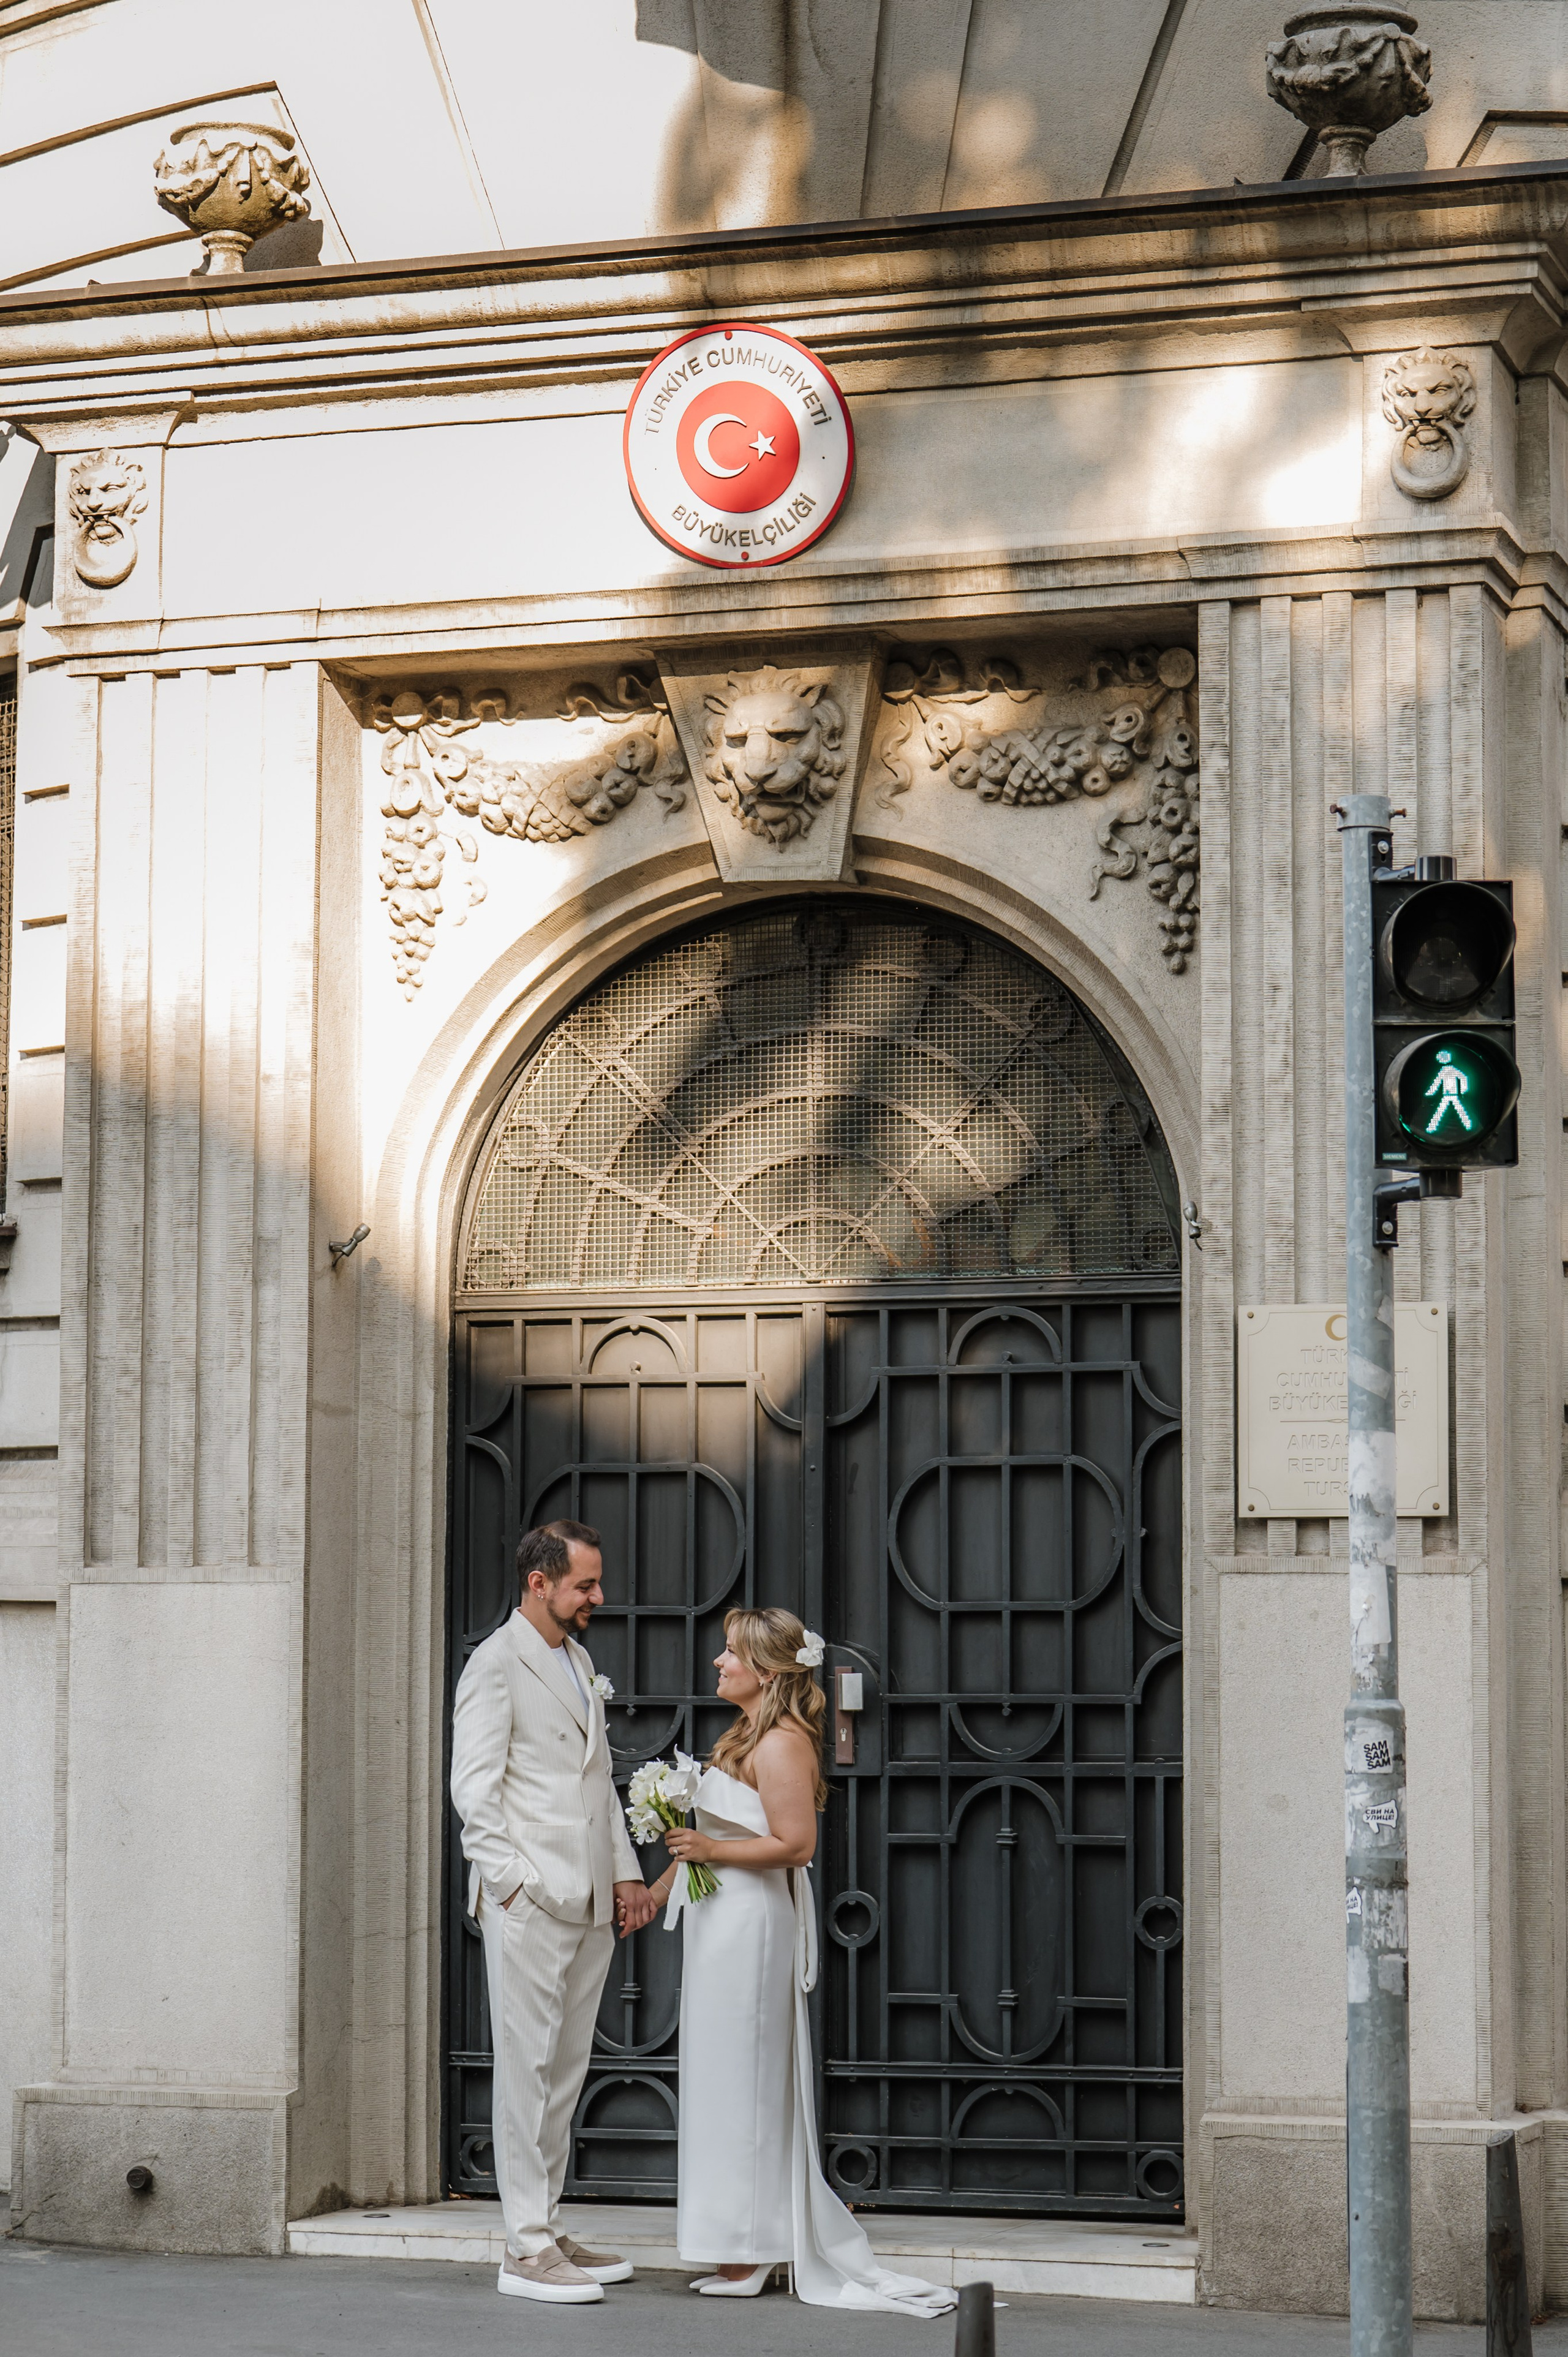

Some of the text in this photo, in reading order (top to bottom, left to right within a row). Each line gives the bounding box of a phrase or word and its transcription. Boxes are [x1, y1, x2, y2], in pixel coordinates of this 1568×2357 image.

[644, 347, 832, 436] TÜRKİYE CUMHURİYETİ
[671, 492, 816, 547] BÜYÜKELÇİLİĞİ
[1363, 1740, 1387, 1752] SAM
[1365, 1748, 1389, 1761] SAM
[1367, 1757, 1391, 1770] SAM
